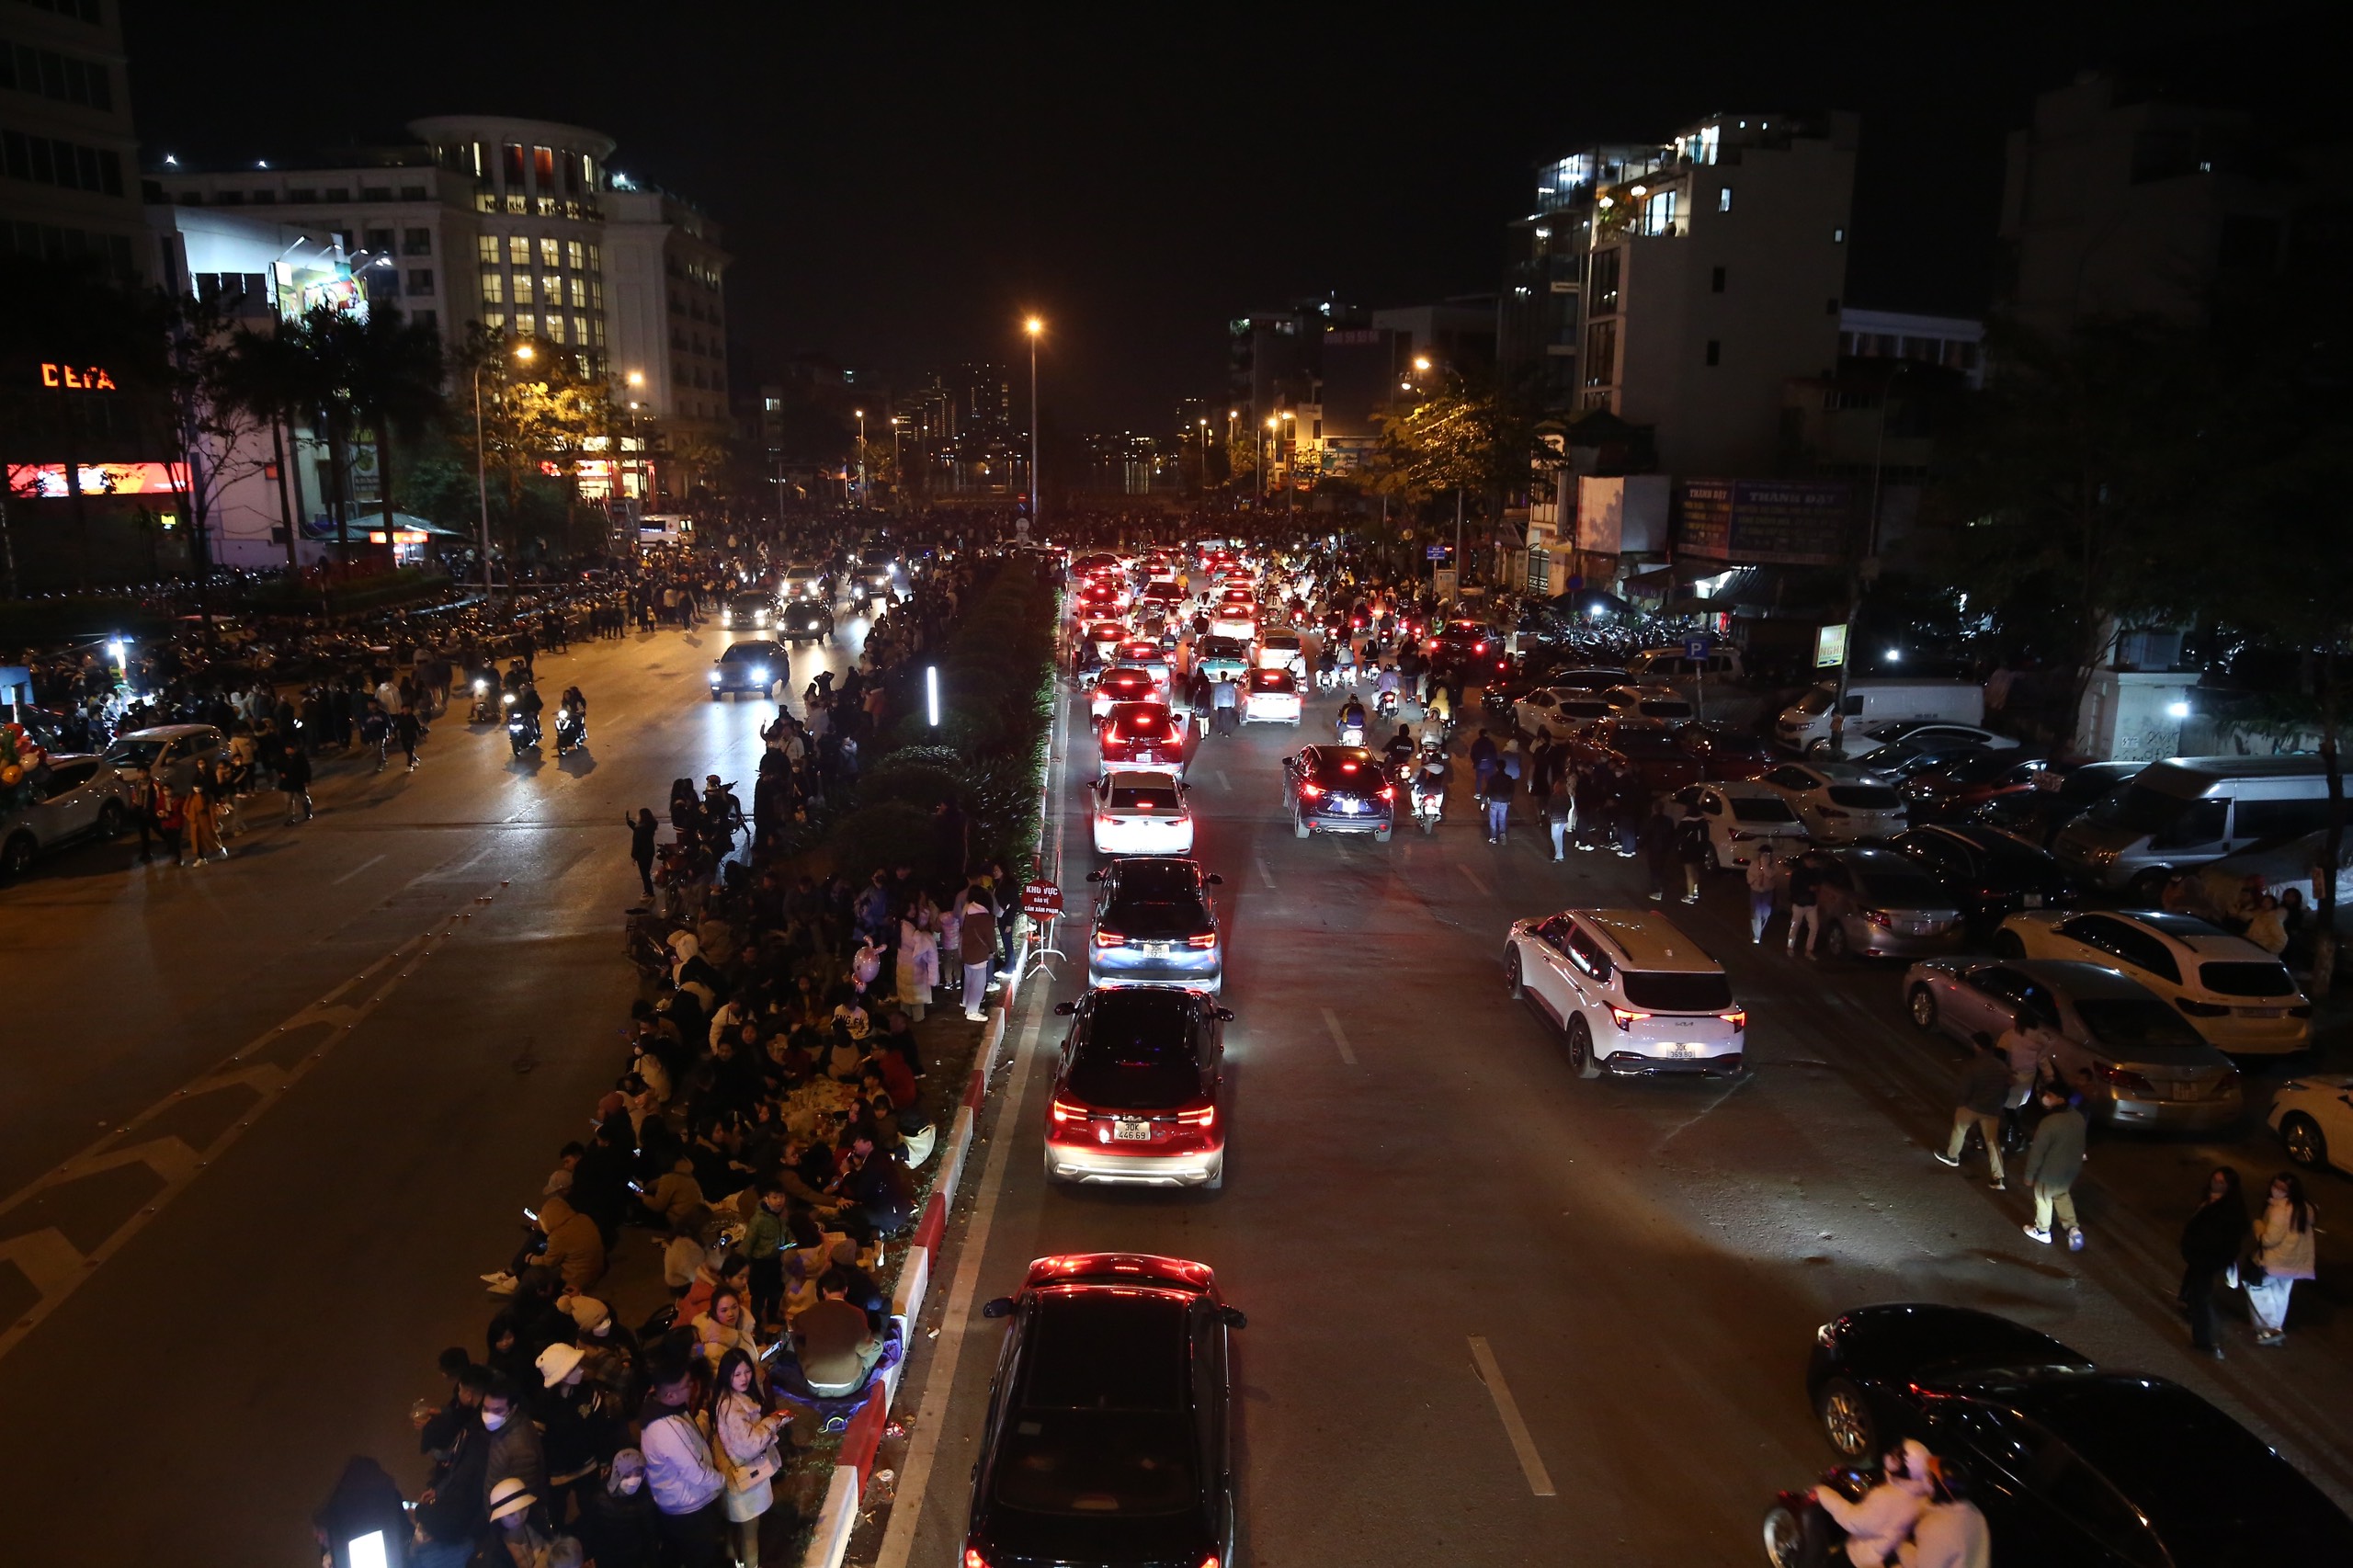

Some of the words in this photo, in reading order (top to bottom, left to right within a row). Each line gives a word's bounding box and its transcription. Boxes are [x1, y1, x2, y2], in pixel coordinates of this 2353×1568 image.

[1691, 642, 1702, 656] P
[1026, 885, 1041, 894] KHU
[1043, 886, 1058, 897] VỰC
[1125, 1123, 1139, 1131] 30K
[1119, 1131, 1145, 1140] 446.69
